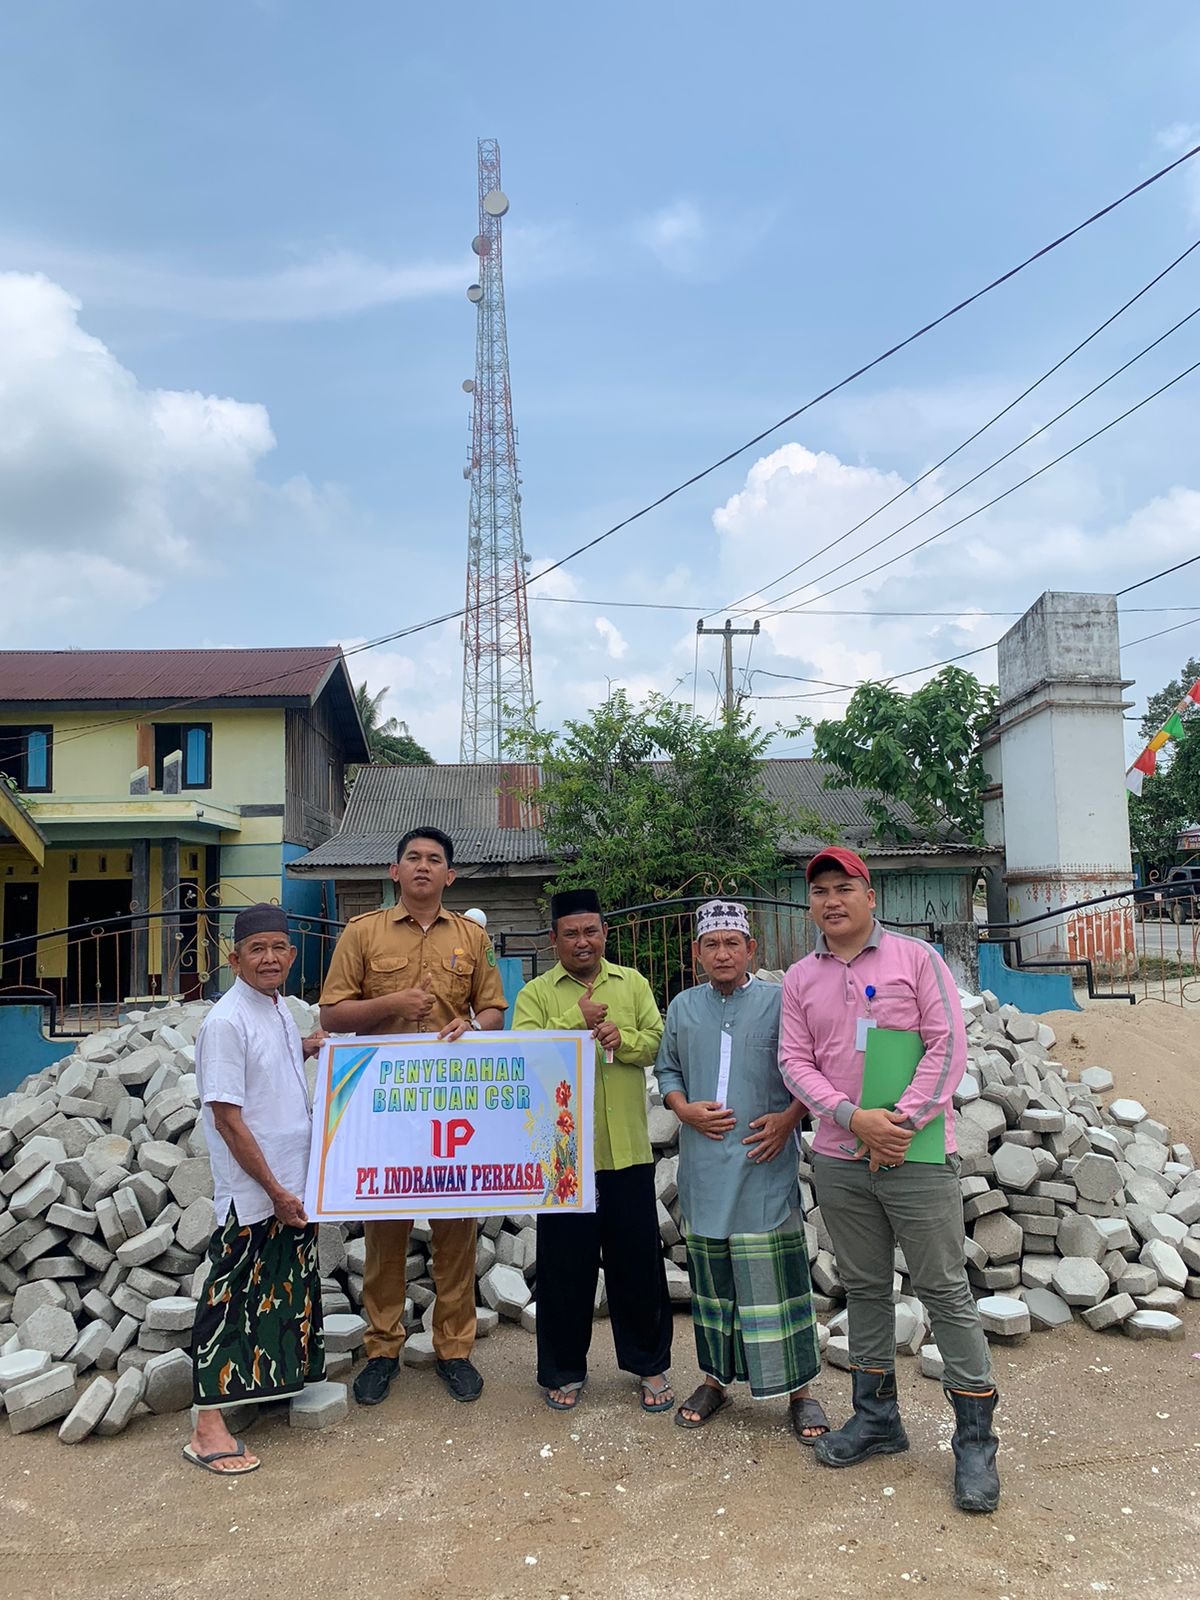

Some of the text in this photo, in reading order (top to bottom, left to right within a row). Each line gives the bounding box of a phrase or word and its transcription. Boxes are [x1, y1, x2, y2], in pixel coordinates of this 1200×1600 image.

[380, 1057, 525, 1084] PENYERAHAN
[373, 1085, 530, 1113] BANTUAN CSR
[356, 1162, 545, 1195] PT. INDRAWAN PERKASA
